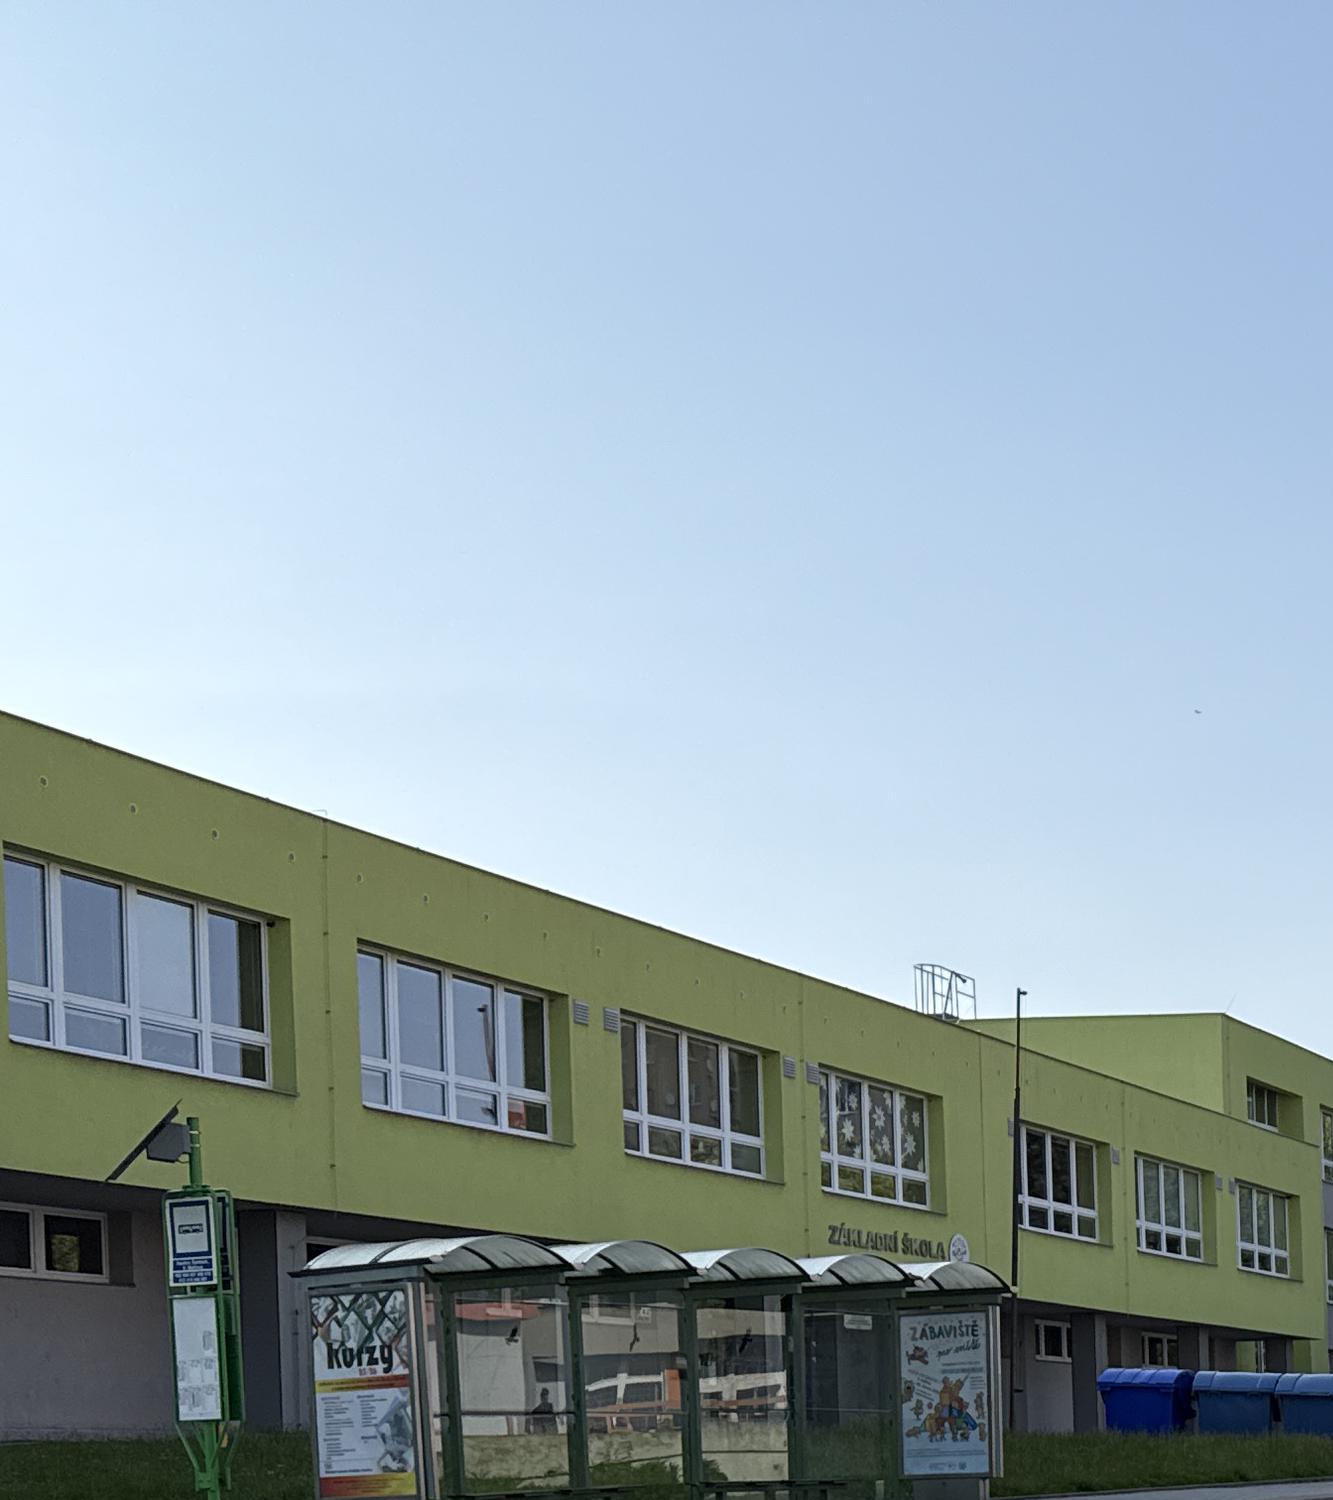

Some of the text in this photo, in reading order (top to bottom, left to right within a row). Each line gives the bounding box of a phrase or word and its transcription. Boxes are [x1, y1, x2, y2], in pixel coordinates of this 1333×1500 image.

[828, 1222, 899, 1254] ZÁKLADNÍ
[901, 1232, 946, 1260] ŠKOLA
[909, 1320, 979, 1341] ZÁBAVIŠTĚ
[327, 1342, 393, 1374] kurzy
